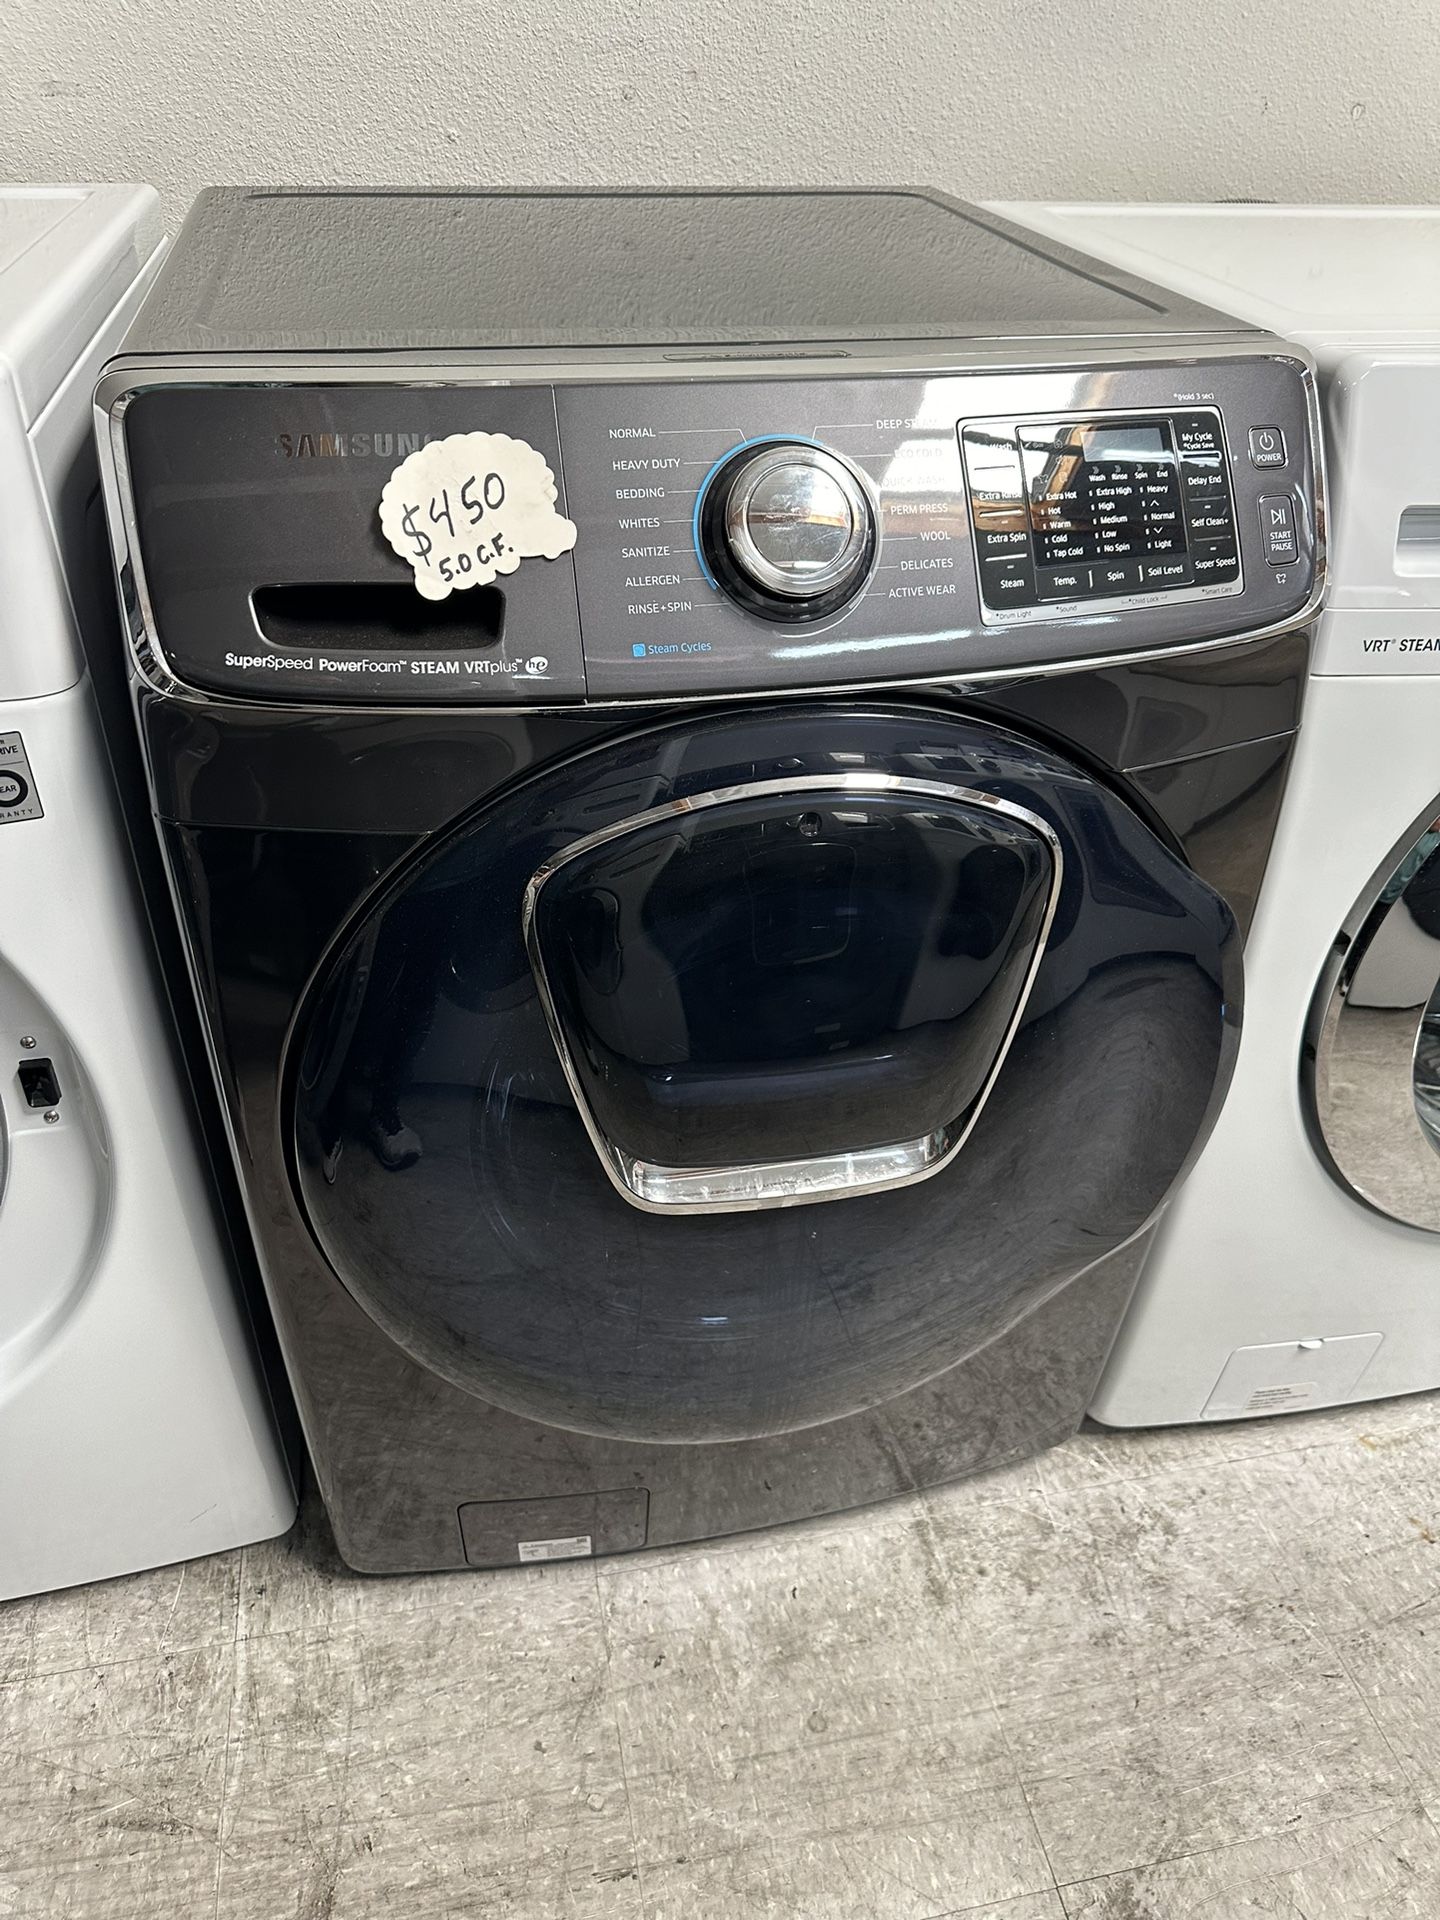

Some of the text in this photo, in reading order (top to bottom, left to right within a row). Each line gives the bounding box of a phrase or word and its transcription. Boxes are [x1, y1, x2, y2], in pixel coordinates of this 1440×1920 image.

[876, 418, 902, 429] DEEP
[609, 427, 656, 439] NORMAL
[1181, 432, 1213, 442] My Cycle
[275, 432, 430, 458] SAMSUN
[1256, 453, 1282, 462] POWER
[612, 458, 680, 471] HEAVY DUTY
[1089, 474, 1106, 482] Wash
[1134, 472, 1148, 480] Spin
[1187, 475, 1222, 486] Delay End
[615, 487, 665, 499] BEDDING
[1096, 486, 1132, 497] Extra High
[1147, 485, 1168, 494] Heavy
[979, 492, 1000, 501] Extra
[1046, 491, 1077, 501] Extra Hot
[891, 503, 948, 516] PERM PRESS
[1047, 506, 1061, 515] Hot
[1098, 502, 1115, 511] High
[402, 473, 505, 567] $450
[1100, 515, 1128, 524] Medium
[1151, 512, 1176, 521] Normal
[618, 518, 660, 529] WHITES
[1049, 520, 1071, 530] Warm
[1191, 517, 1229, 528] Self Clean+
[920, 531, 951, 542] WOOL
[987, 532, 1027, 544] Extra Spin
[1051, 534, 1068, 544] Cold
[1102, 530, 1117, 539] Low
[1269, 530, 1292, 540] START
[1104, 542, 1130, 553] No Spin
[1154, 540, 1172, 549] Light
[1270, 541, 1293, 551] PAUSE
[621, 546, 670, 558] SANITIZE
[1053, 547, 1084, 559] Tap Cold
[438, 553, 473, 583] 5.0
[900, 558, 954, 571] DELICATES
[1195, 557, 1237, 570] Super Speed
[1107, 570, 1125, 582] Spin
[1147, 564, 1184, 577] Soil Level
[625, 575, 680, 587] ALLERGEN
[1000, 578, 1025, 589] Steam
[1053, 576, 1078, 587] Temp.
[888, 584, 957, 598] ACTIVE WEAR
[628, 601, 692, 614] RINSE+SPIN
[1017, 610, 1032, 619] Light
[648, 641, 712, 655] Steam Cycles
[225, 652, 313, 670] SuperSpeed
[411, 660, 459, 675] STEAM
